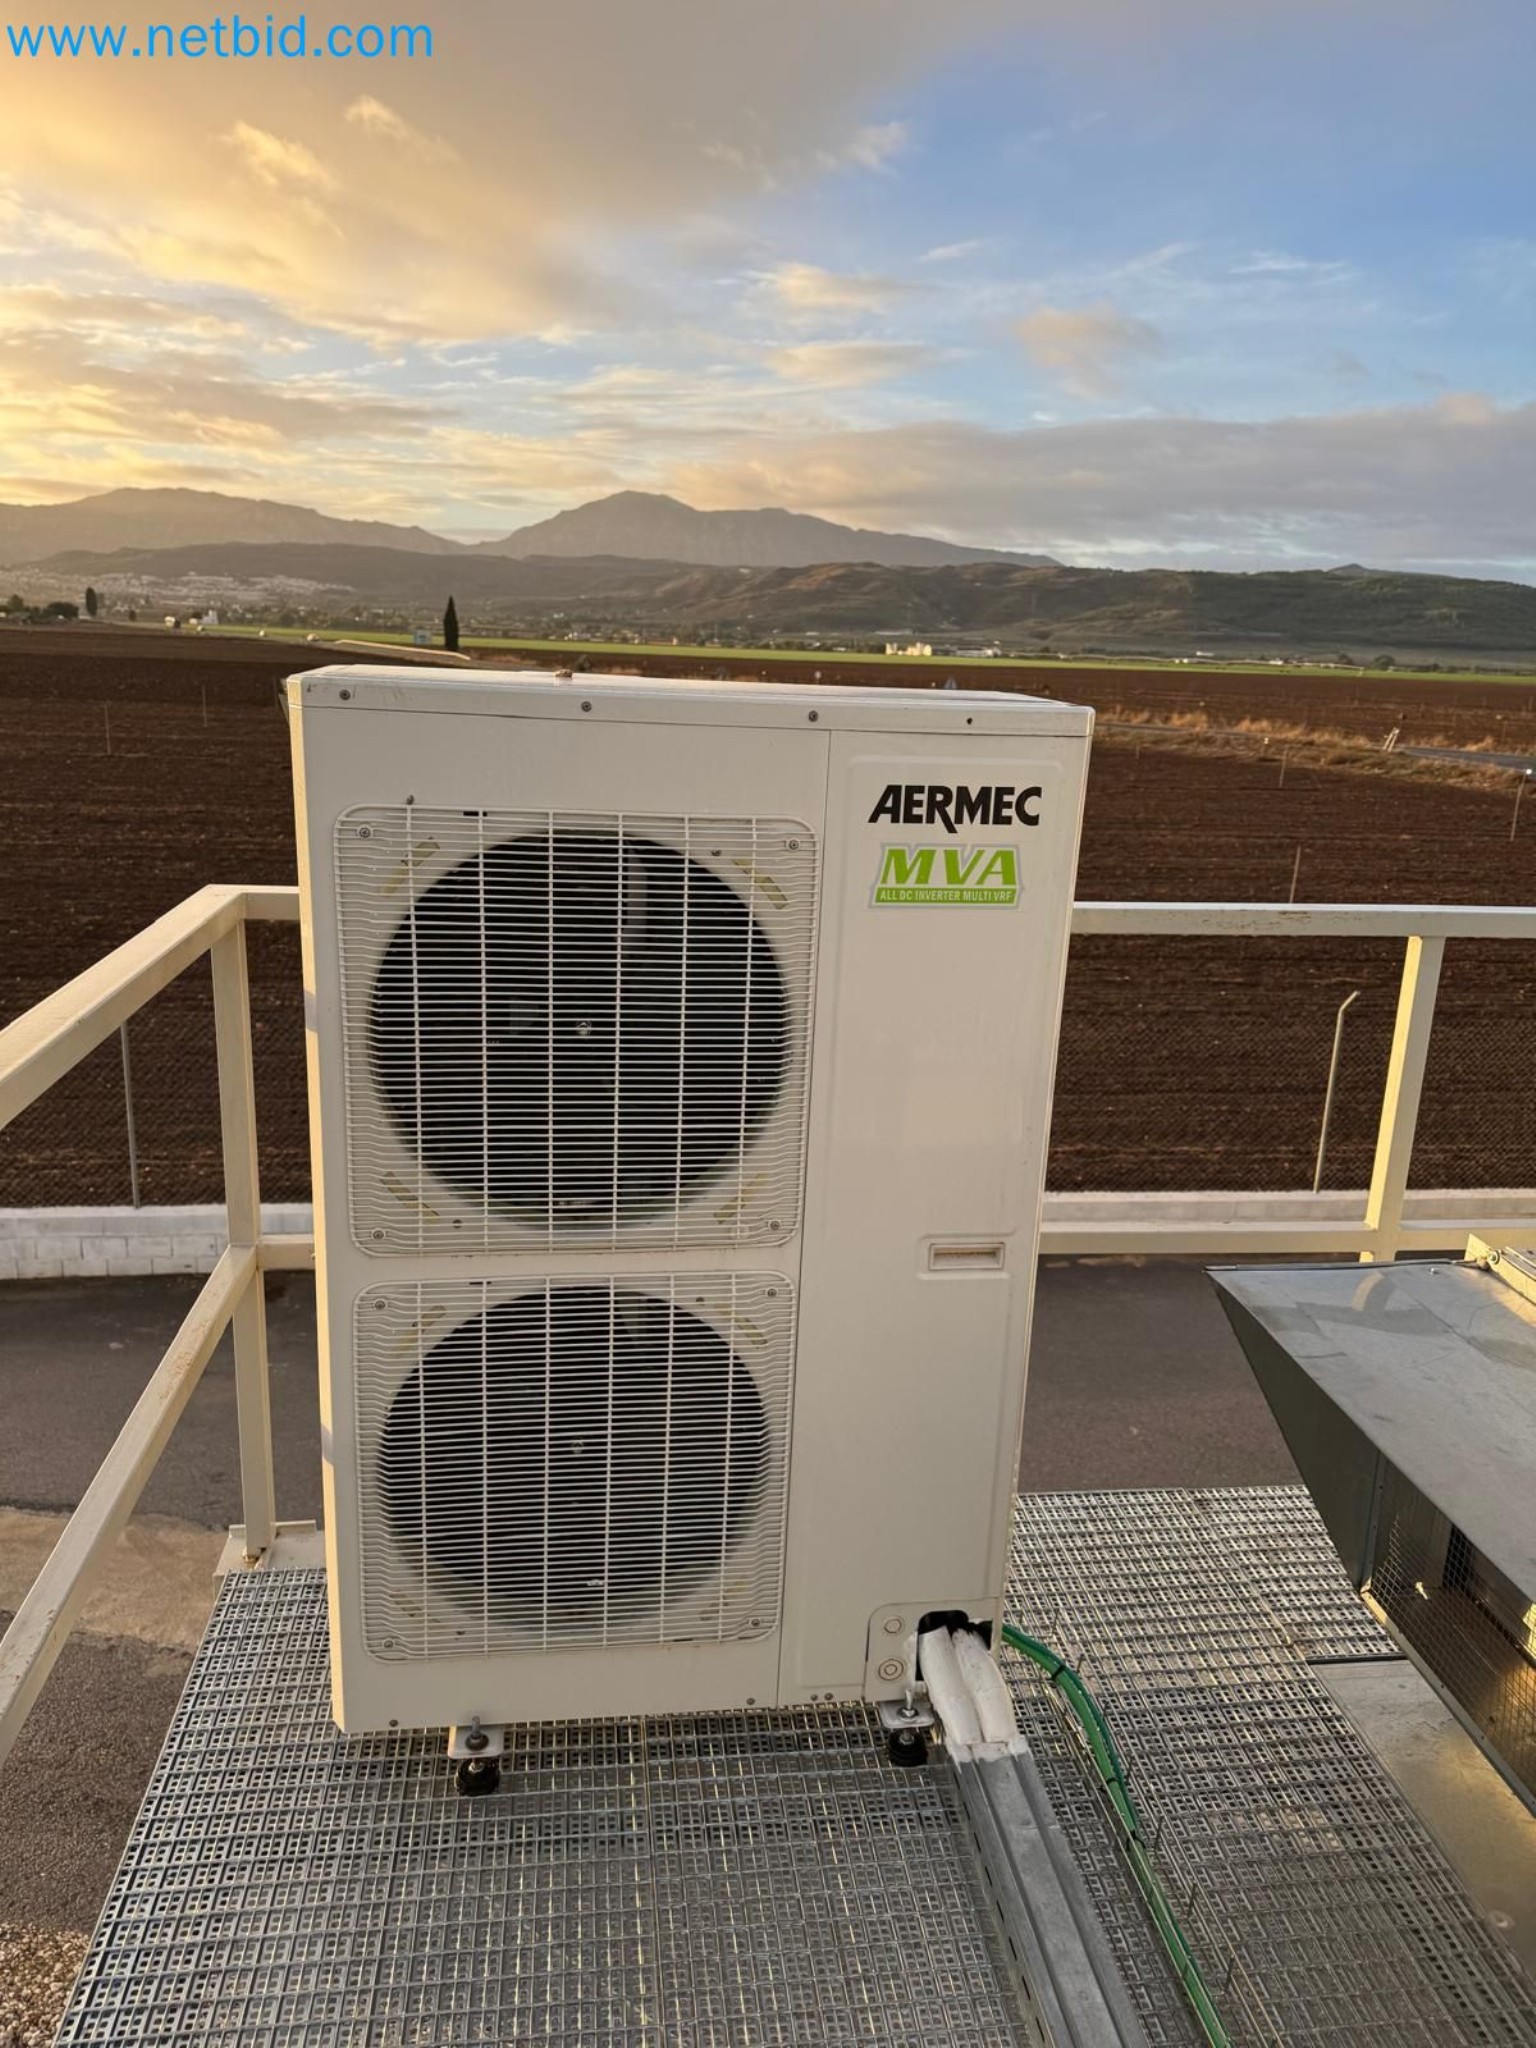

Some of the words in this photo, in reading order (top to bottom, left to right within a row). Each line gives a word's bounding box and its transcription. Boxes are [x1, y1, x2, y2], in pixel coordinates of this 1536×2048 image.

[868, 785, 1042, 833] AERMEC
[880, 848, 1017, 885] MVA
[880, 890, 897, 901] ALL
[900, 890, 912, 901] DC
[915, 890, 960, 901] INVERTER
[963, 890, 991, 901] MULTI
[993, 890, 1012, 901] VRF
